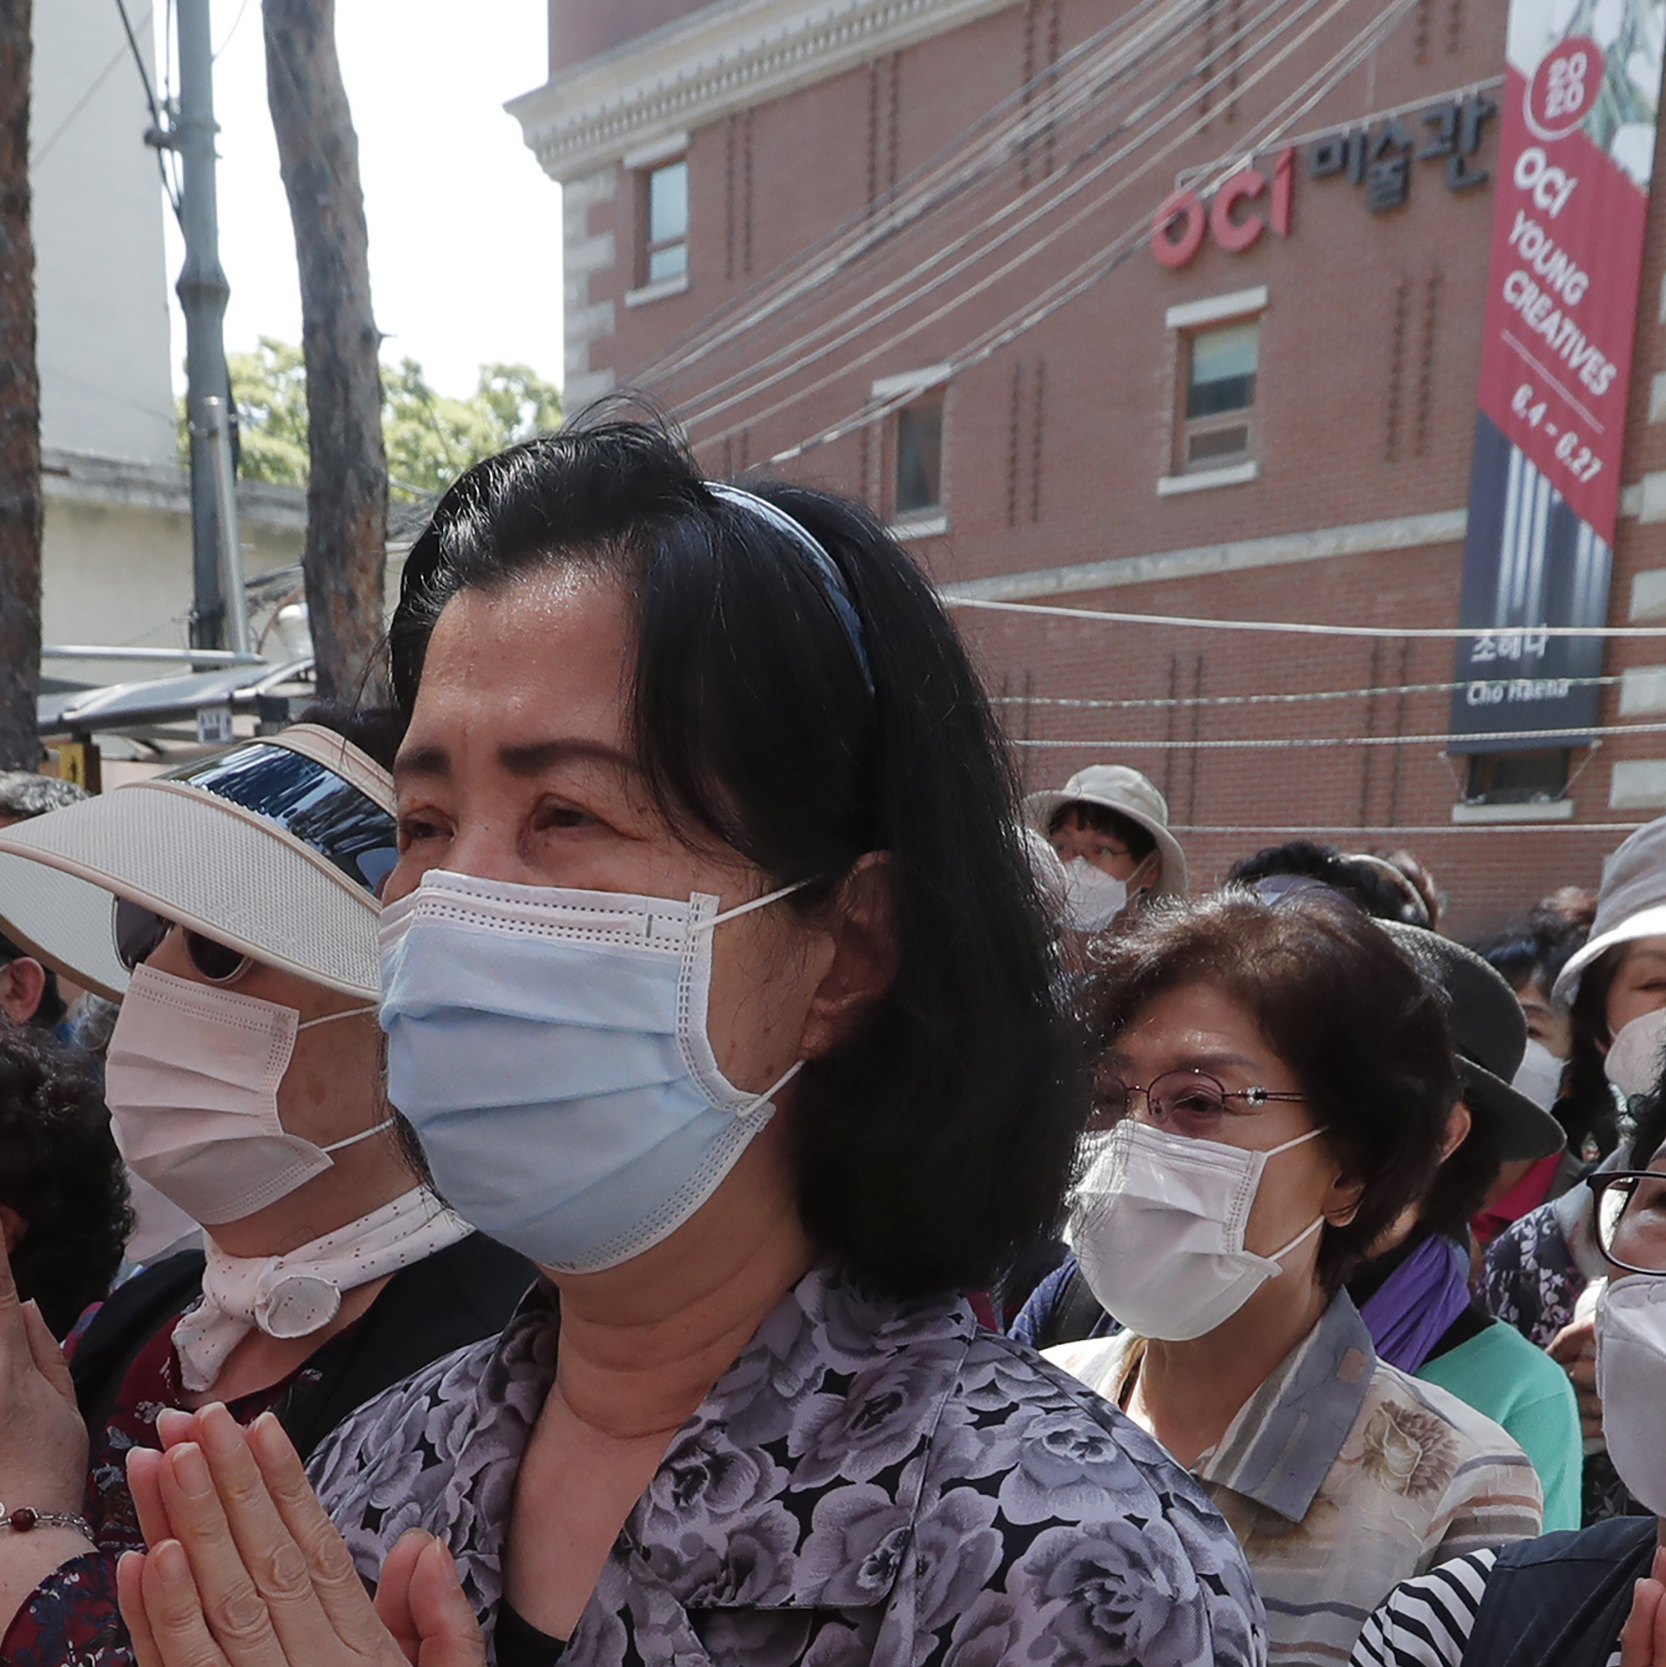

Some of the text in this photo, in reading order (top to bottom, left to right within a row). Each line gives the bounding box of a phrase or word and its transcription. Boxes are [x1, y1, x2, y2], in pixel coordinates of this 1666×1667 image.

[1548, 51, 1588, 89] 20
[1307, 93, 1499, 214] 미술관
[1513, 147, 1578, 219] OCI
[1508, 209, 1590, 306] YOUNG
[1502, 270, 1617, 395] CREATIVES
[1511, 384, 1548, 427] 6.4
[1555, 431, 1603, 483] 6.27
